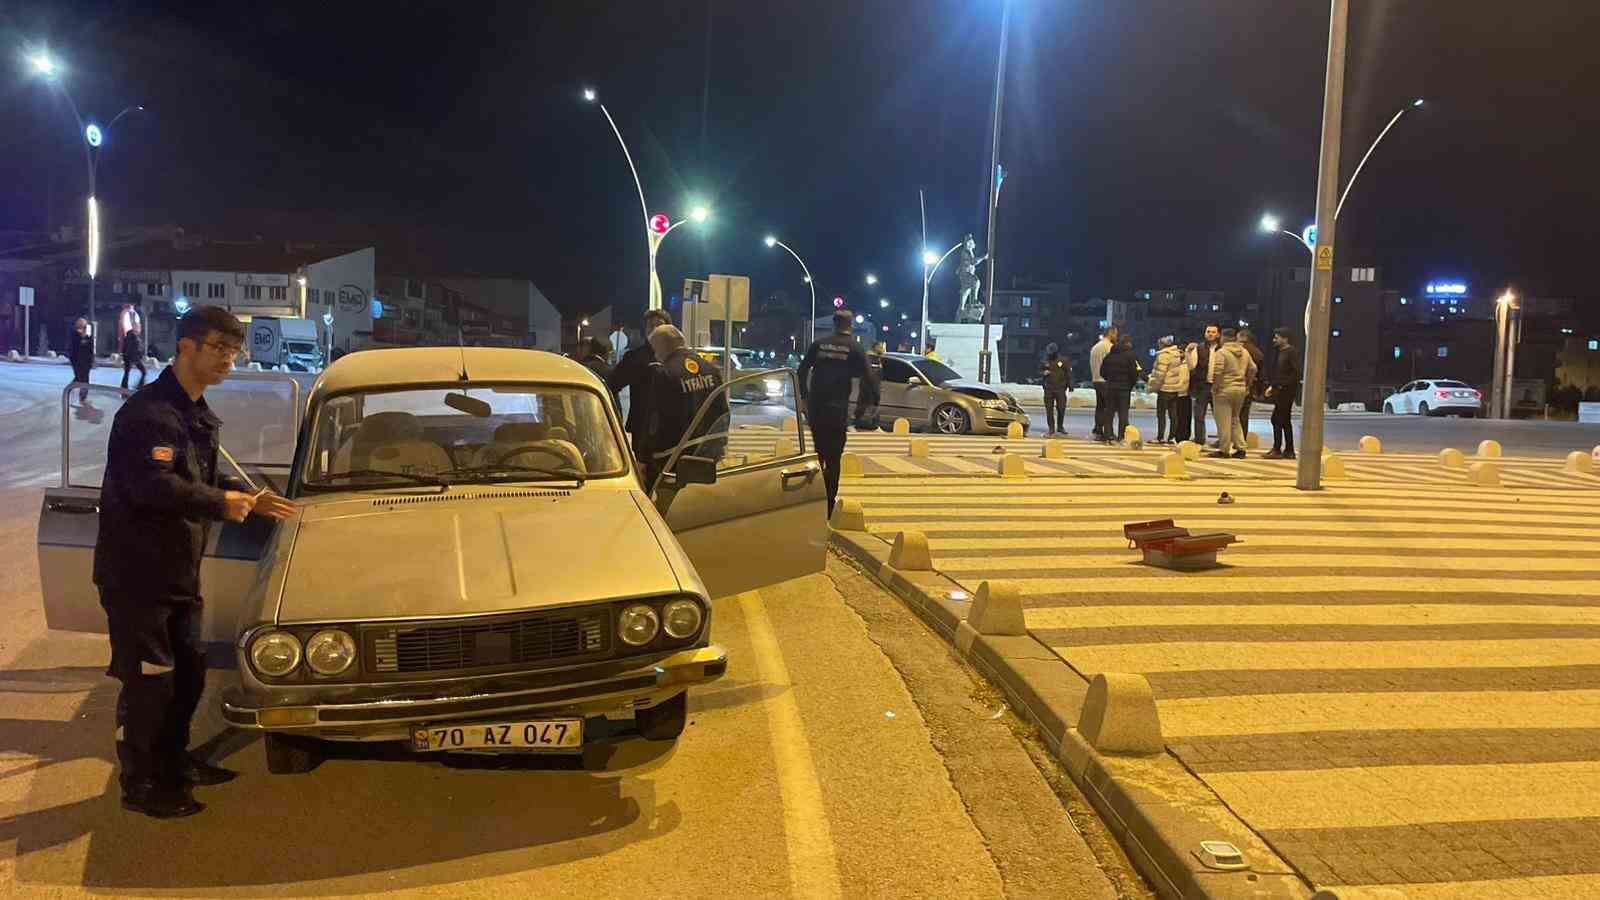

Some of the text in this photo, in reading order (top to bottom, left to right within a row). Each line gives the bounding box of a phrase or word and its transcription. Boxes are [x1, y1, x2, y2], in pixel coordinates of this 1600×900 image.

[434, 723, 568, 747] 70 AZ 047
